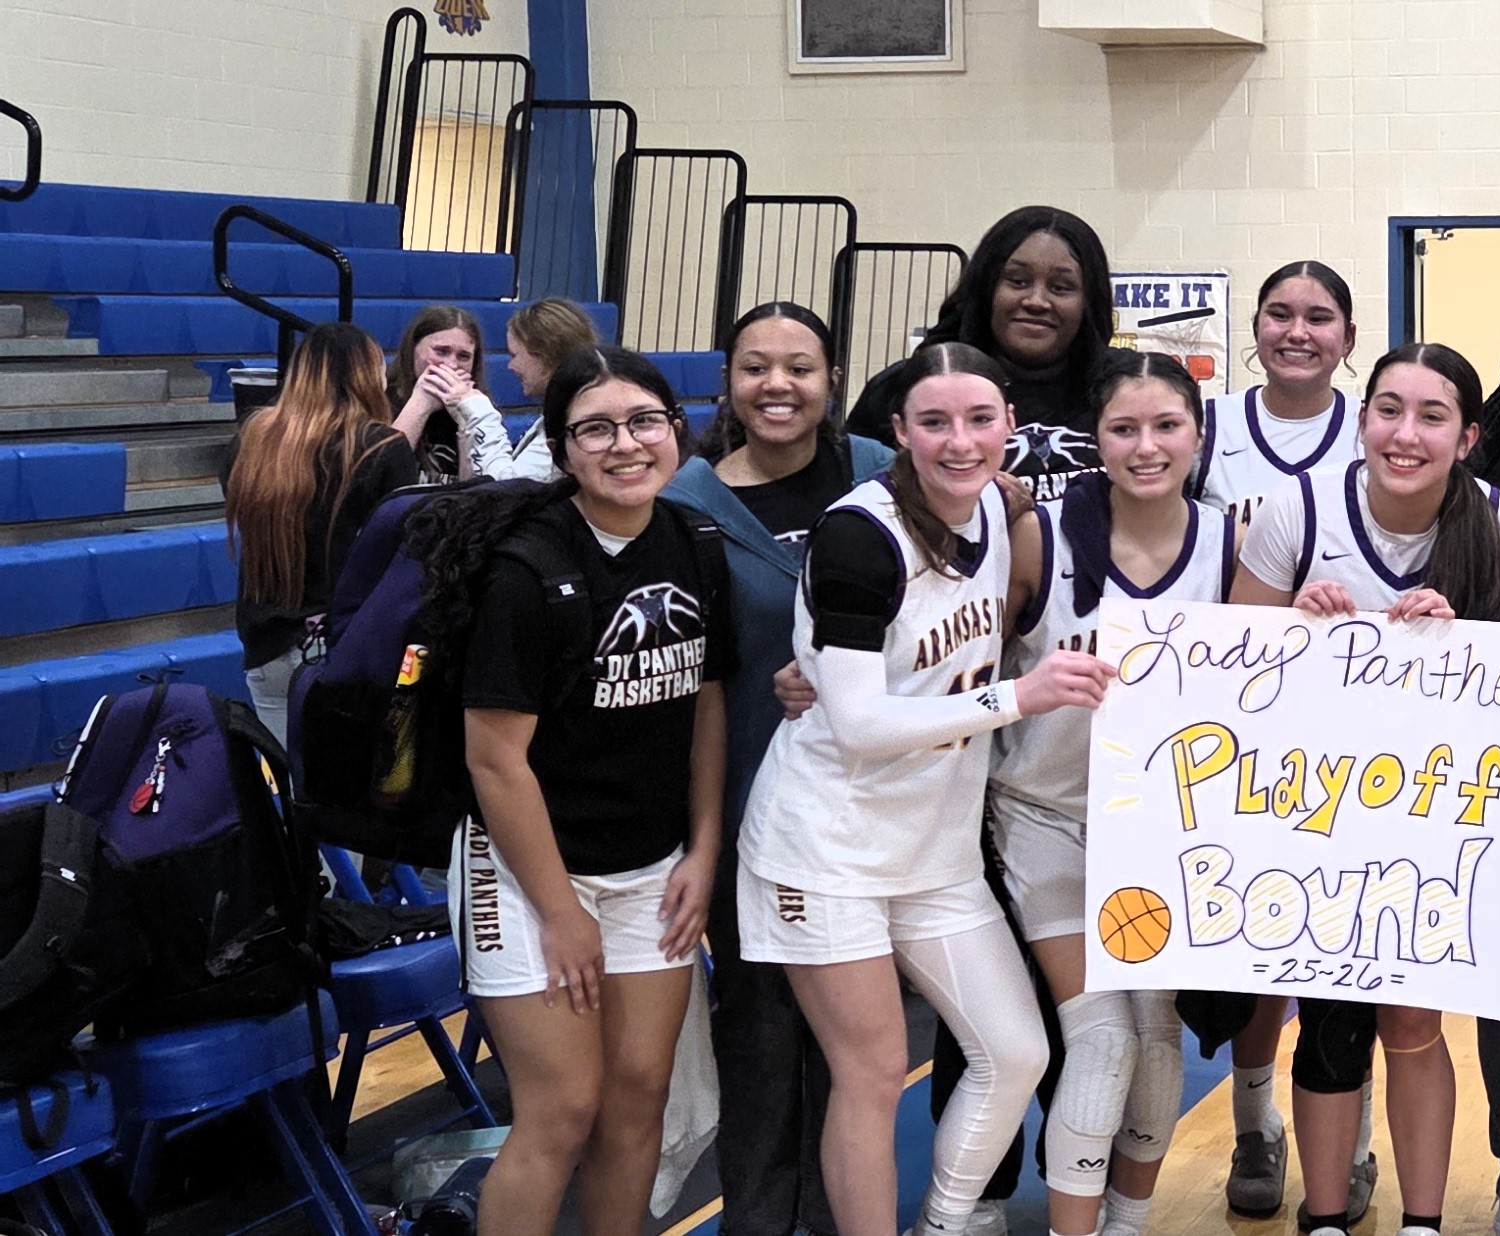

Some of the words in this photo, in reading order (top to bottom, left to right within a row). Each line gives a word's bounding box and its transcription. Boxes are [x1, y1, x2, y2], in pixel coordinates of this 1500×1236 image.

[1112, 283, 1170, 308] AKE
[1181, 283, 1212, 308] IT
[594, 655, 635, 683] DY
[913, 598, 992, 672] ARANSAS
[1118, 609, 1311, 714] Lady
[469, 823, 491, 860] ADY
[470, 868, 504, 953] PANTHERS
[1178, 837, 1495, 967] Bound
